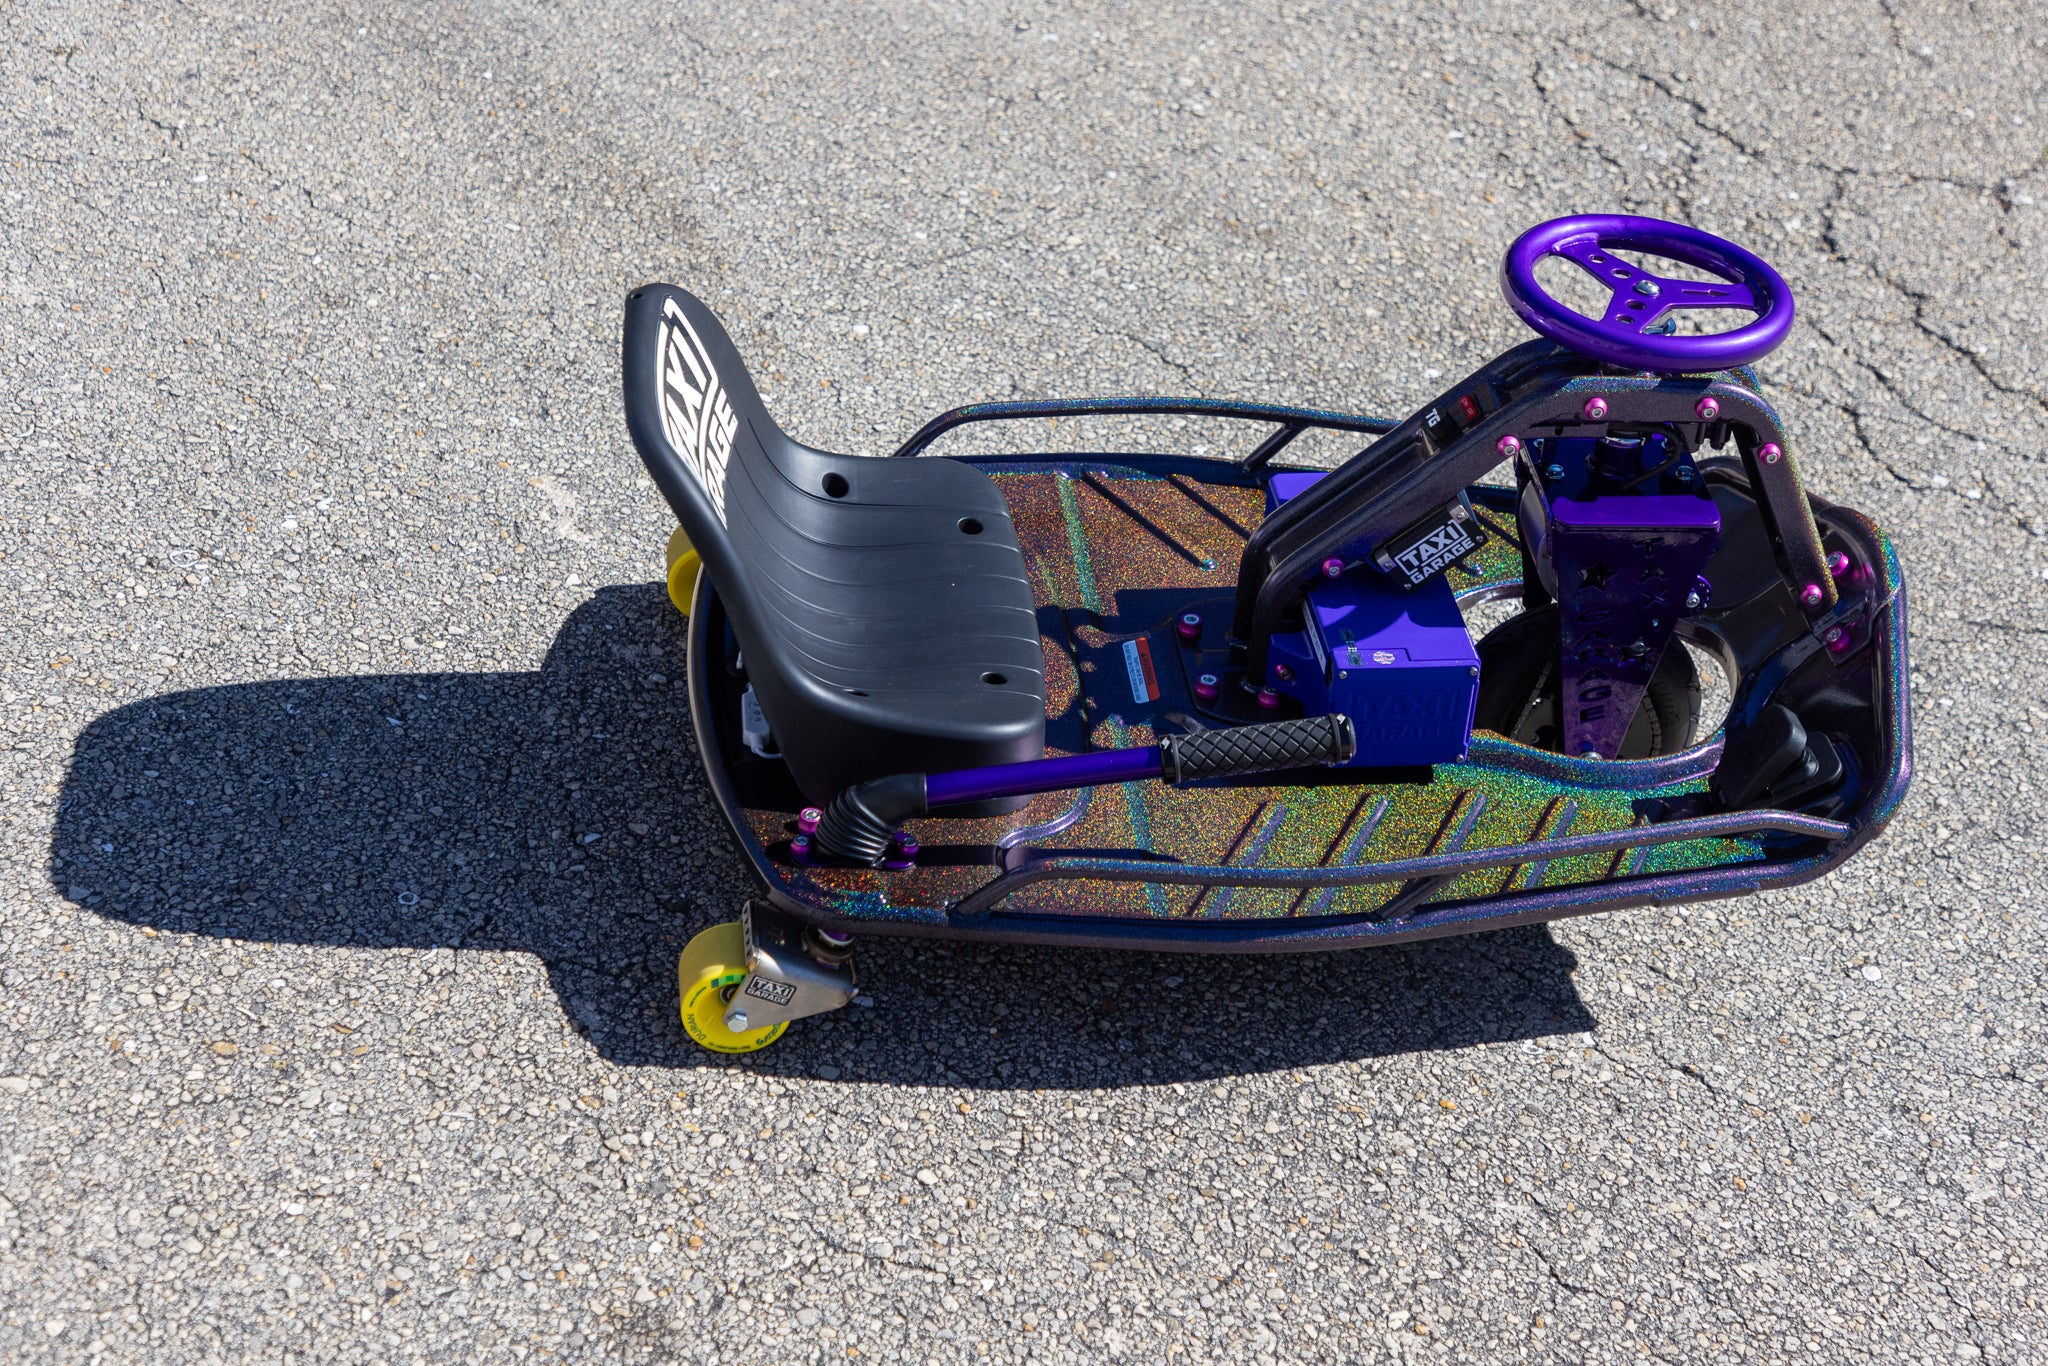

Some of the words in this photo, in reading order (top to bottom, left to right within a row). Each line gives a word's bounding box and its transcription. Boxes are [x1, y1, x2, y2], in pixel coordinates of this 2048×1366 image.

[1425, 407, 1441, 428] TG
[705, 388, 738, 531] RAGE
[1401, 525, 1460, 567] TAXI
[1410, 537, 1475, 584] GARAGE
[1576, 606, 1612, 724] GARAGE
[1357, 724, 1457, 743] ARAGE
[747, 988, 789, 1005] GARAGE
[756, 979, 791, 996] TAXI
[687, 1013, 707, 1041] DURIAN
